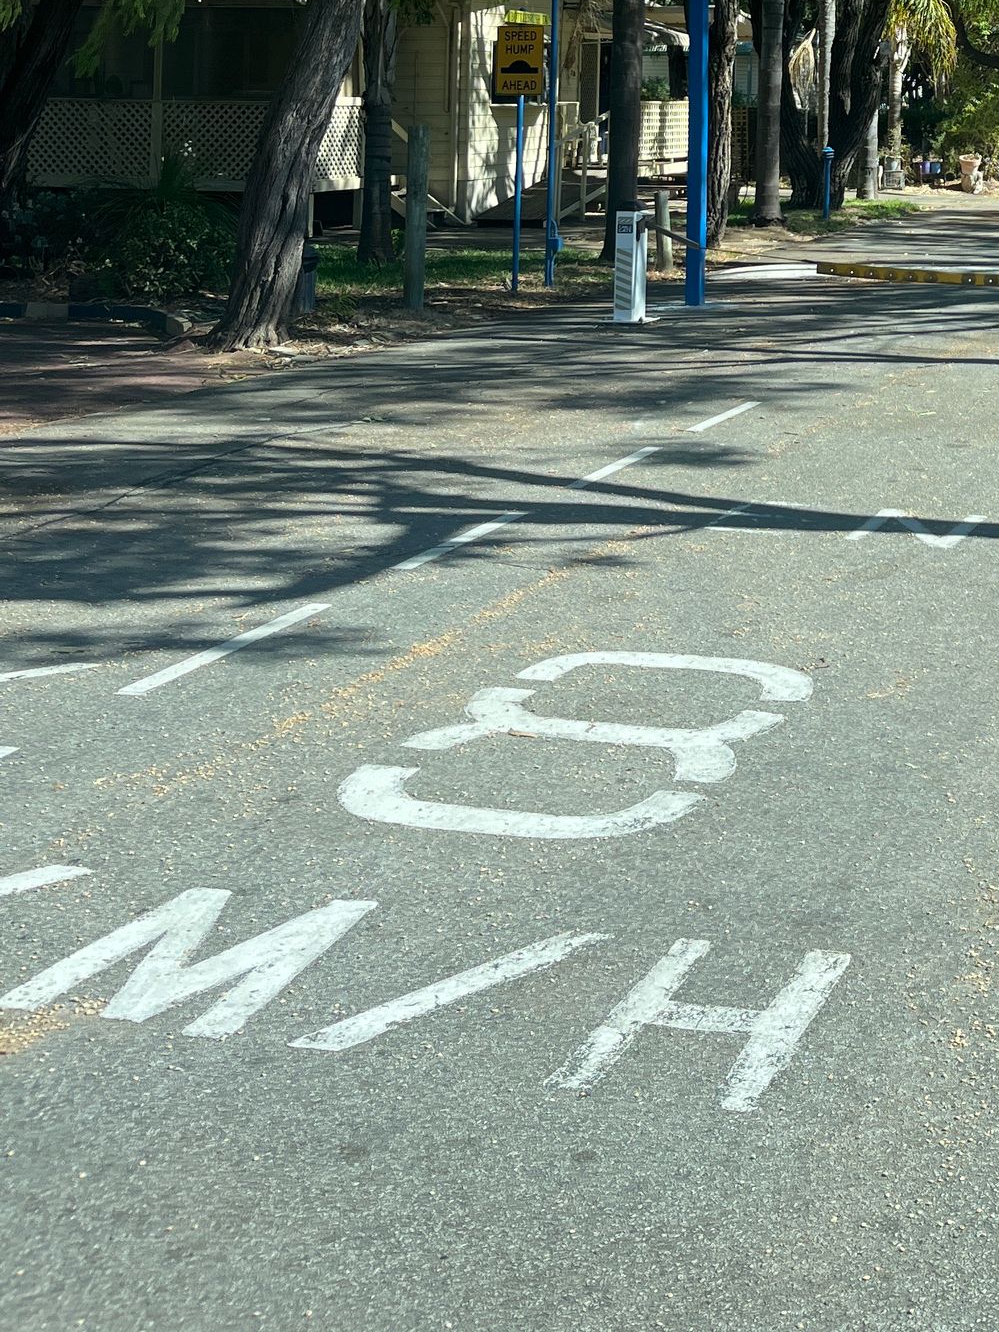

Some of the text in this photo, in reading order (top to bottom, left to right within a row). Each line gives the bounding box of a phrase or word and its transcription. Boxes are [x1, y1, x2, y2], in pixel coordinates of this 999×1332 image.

[504, 30, 537, 41] SPEED
[505, 44, 535, 55] HUMP
[502, 80, 537, 90] AHEAD
[337, 651, 814, 839] 8
